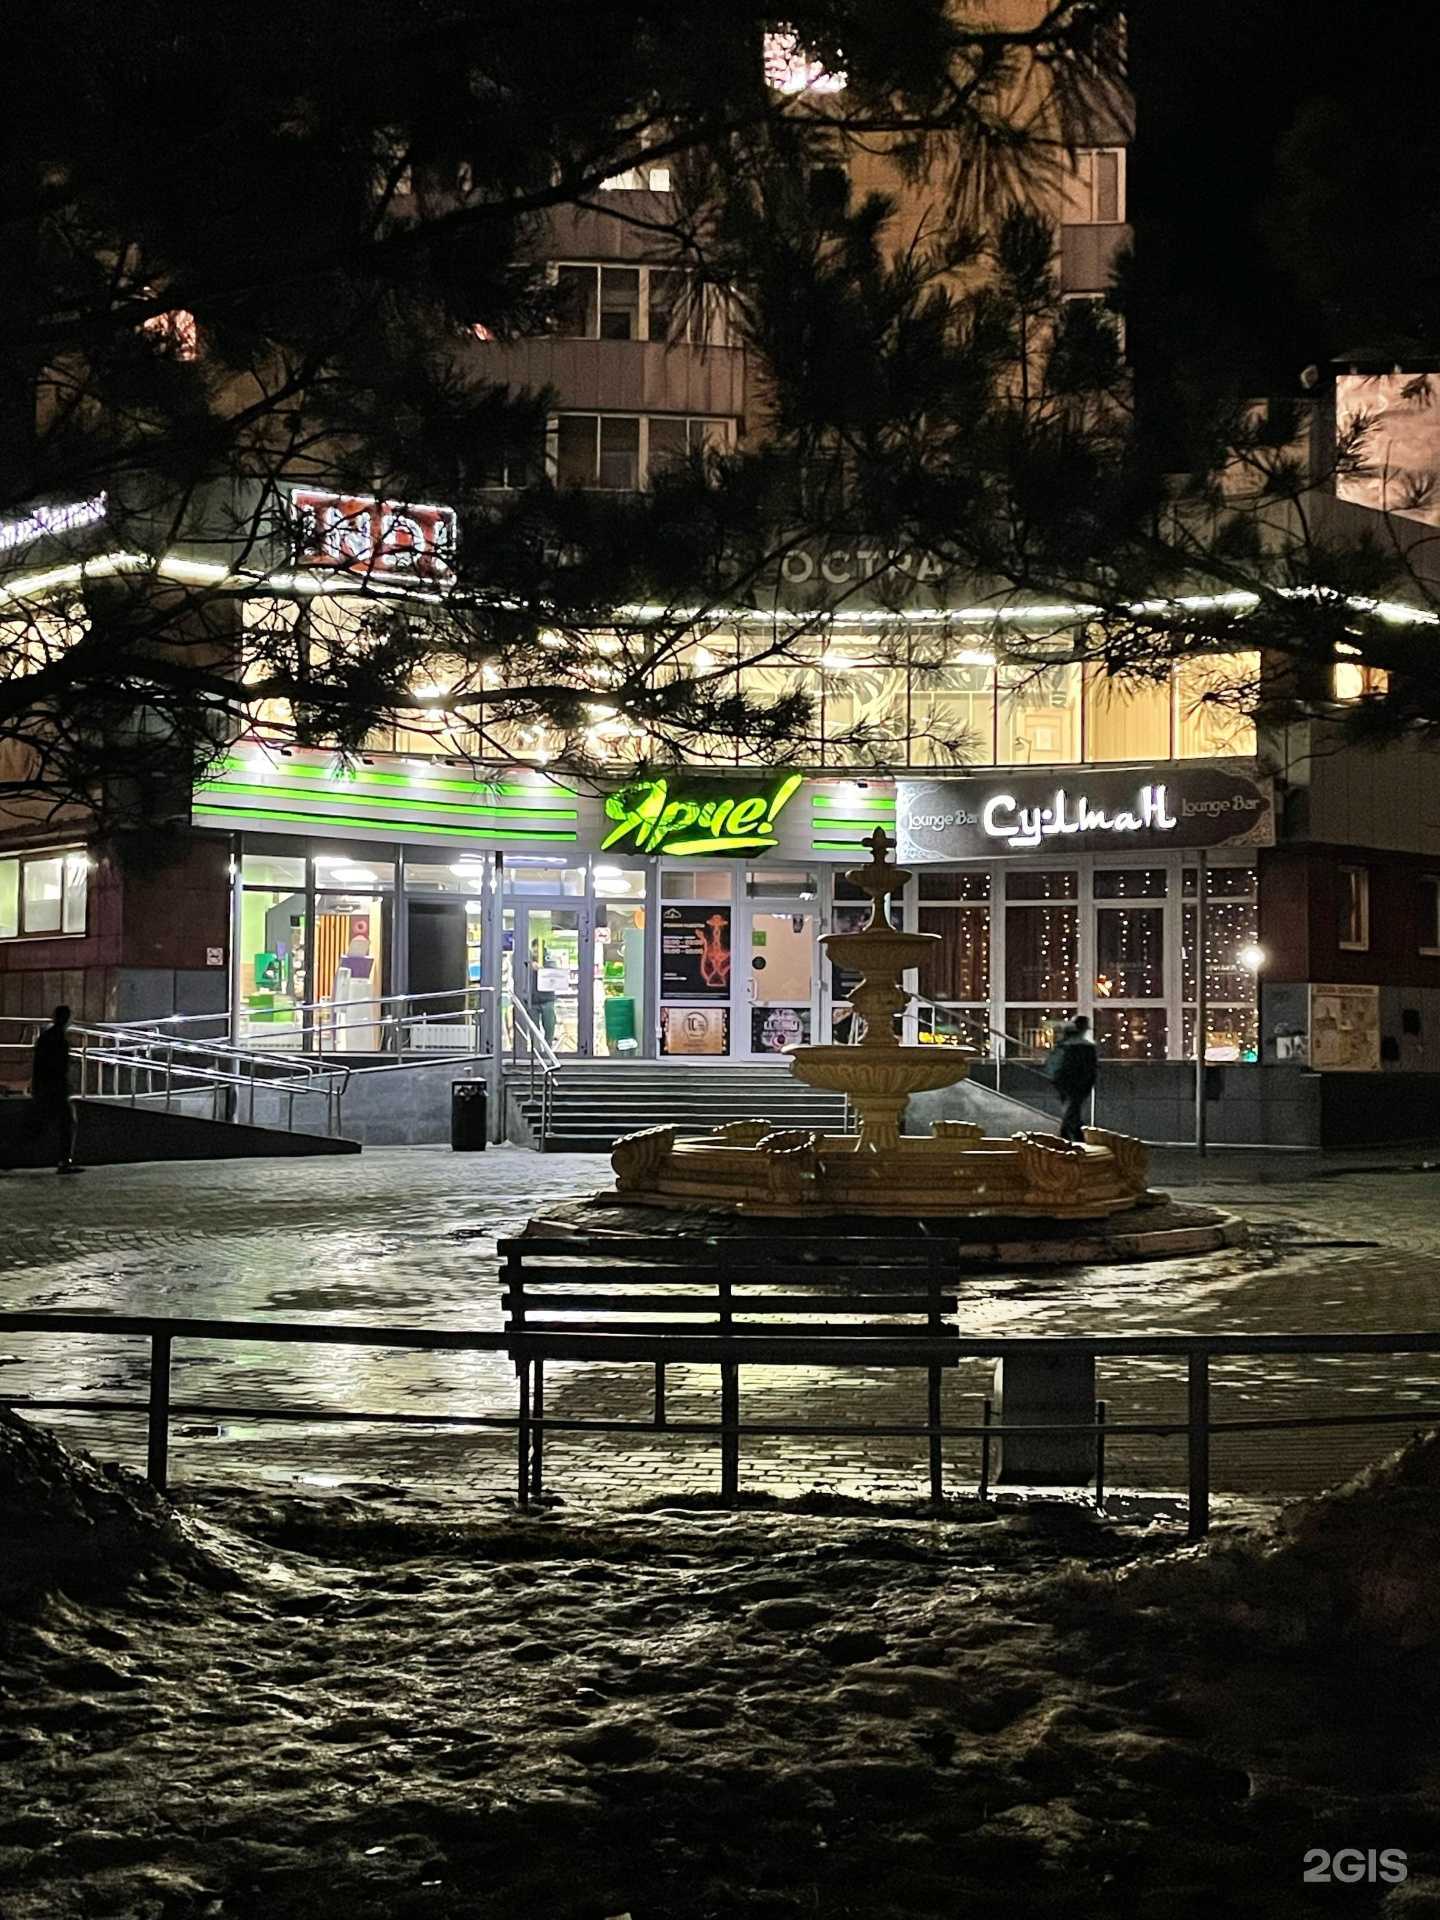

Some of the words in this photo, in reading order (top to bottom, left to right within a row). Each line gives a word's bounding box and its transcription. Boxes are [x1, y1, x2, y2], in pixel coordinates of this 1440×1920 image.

[601, 774, 803, 854] Ярче!
[1182, 798, 1230, 817] Lounge
[1232, 795, 1260, 811] Bar
[908, 812, 953, 831] Lounge
